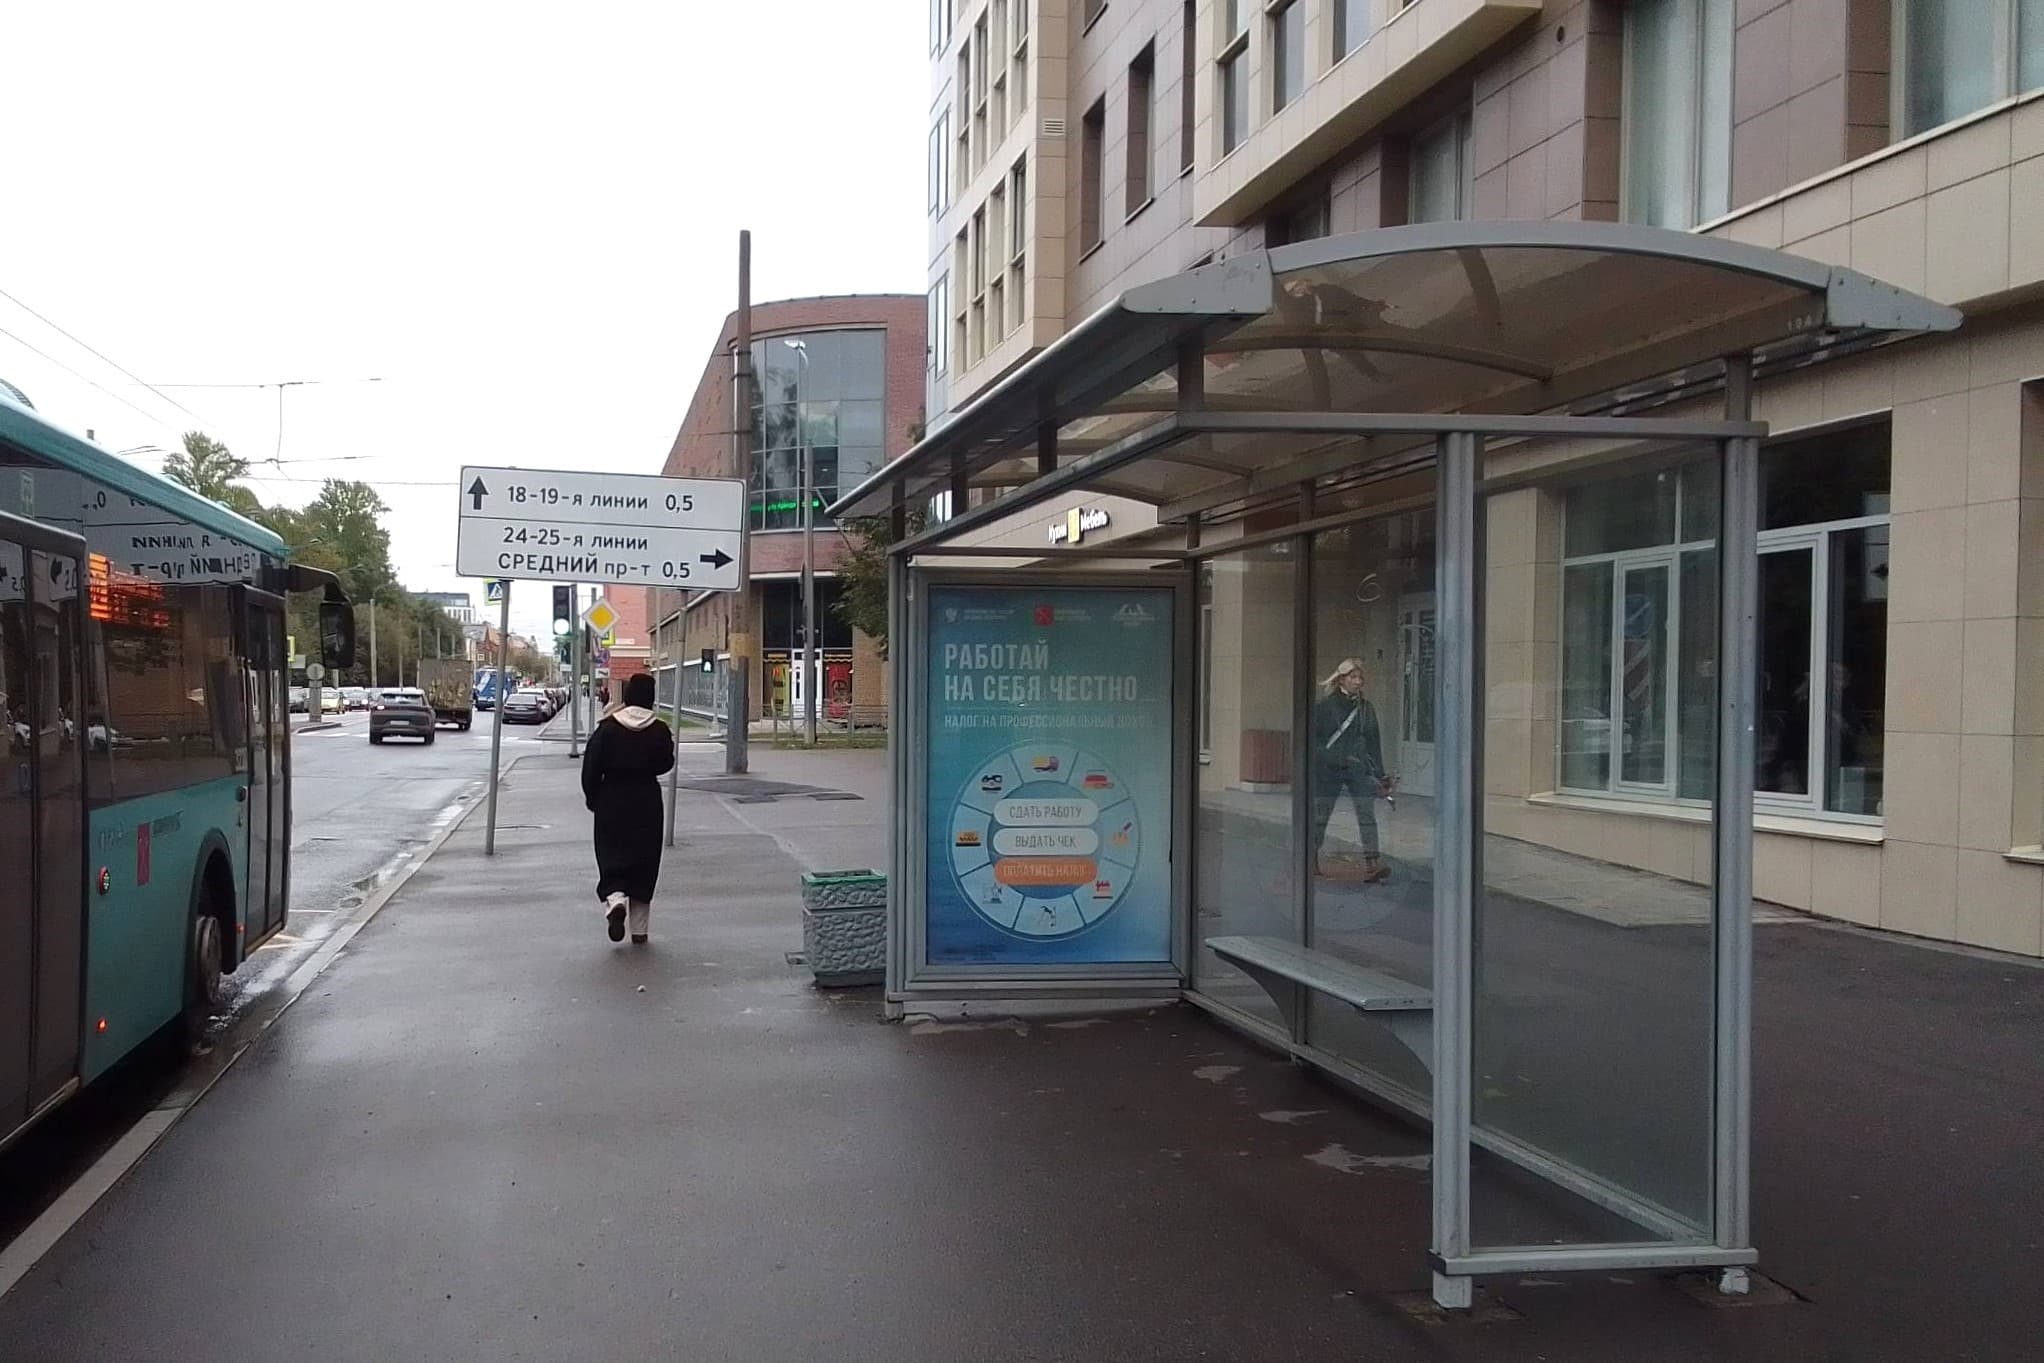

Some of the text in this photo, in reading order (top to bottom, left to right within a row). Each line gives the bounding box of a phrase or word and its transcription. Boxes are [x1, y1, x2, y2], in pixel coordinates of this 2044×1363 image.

[507, 486, 694, 514] 18-19-я линии 0,5
[503, 526, 648, 551] 24-25-я линии
[498, 552, 691, 579] СРЕДНИЙ пр-т 0,5
[945, 639, 1049, 670] РАБОТАЙ
[945, 675, 1137, 701] НА СЕБЯ ЧЕСТНО
[945, 714, 979, 728] НАЛОГ
[983, 714, 997, 728] НА
[1009, 804, 1082, 819] СДАТЬ РАБОТУ
[1015, 834, 1077, 849] ВЫДАТЬ ЧЕК
